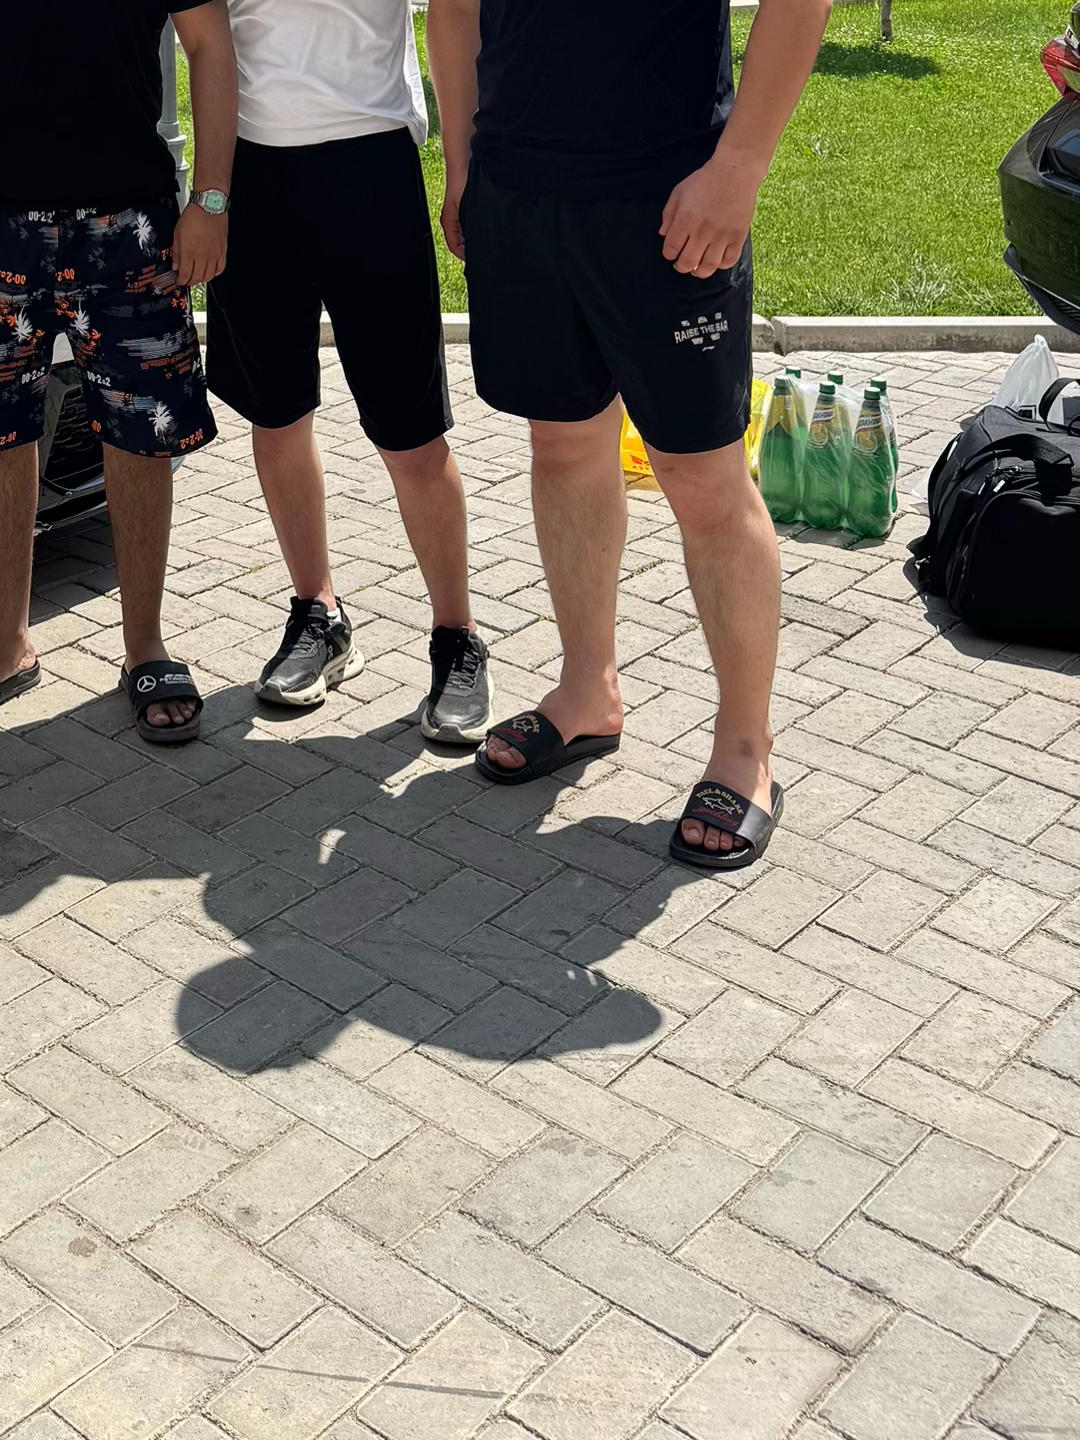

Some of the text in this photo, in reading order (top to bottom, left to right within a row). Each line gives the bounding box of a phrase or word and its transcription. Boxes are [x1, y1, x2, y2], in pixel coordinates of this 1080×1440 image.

[674, 320, 729, 344] RAISE THE BAR
